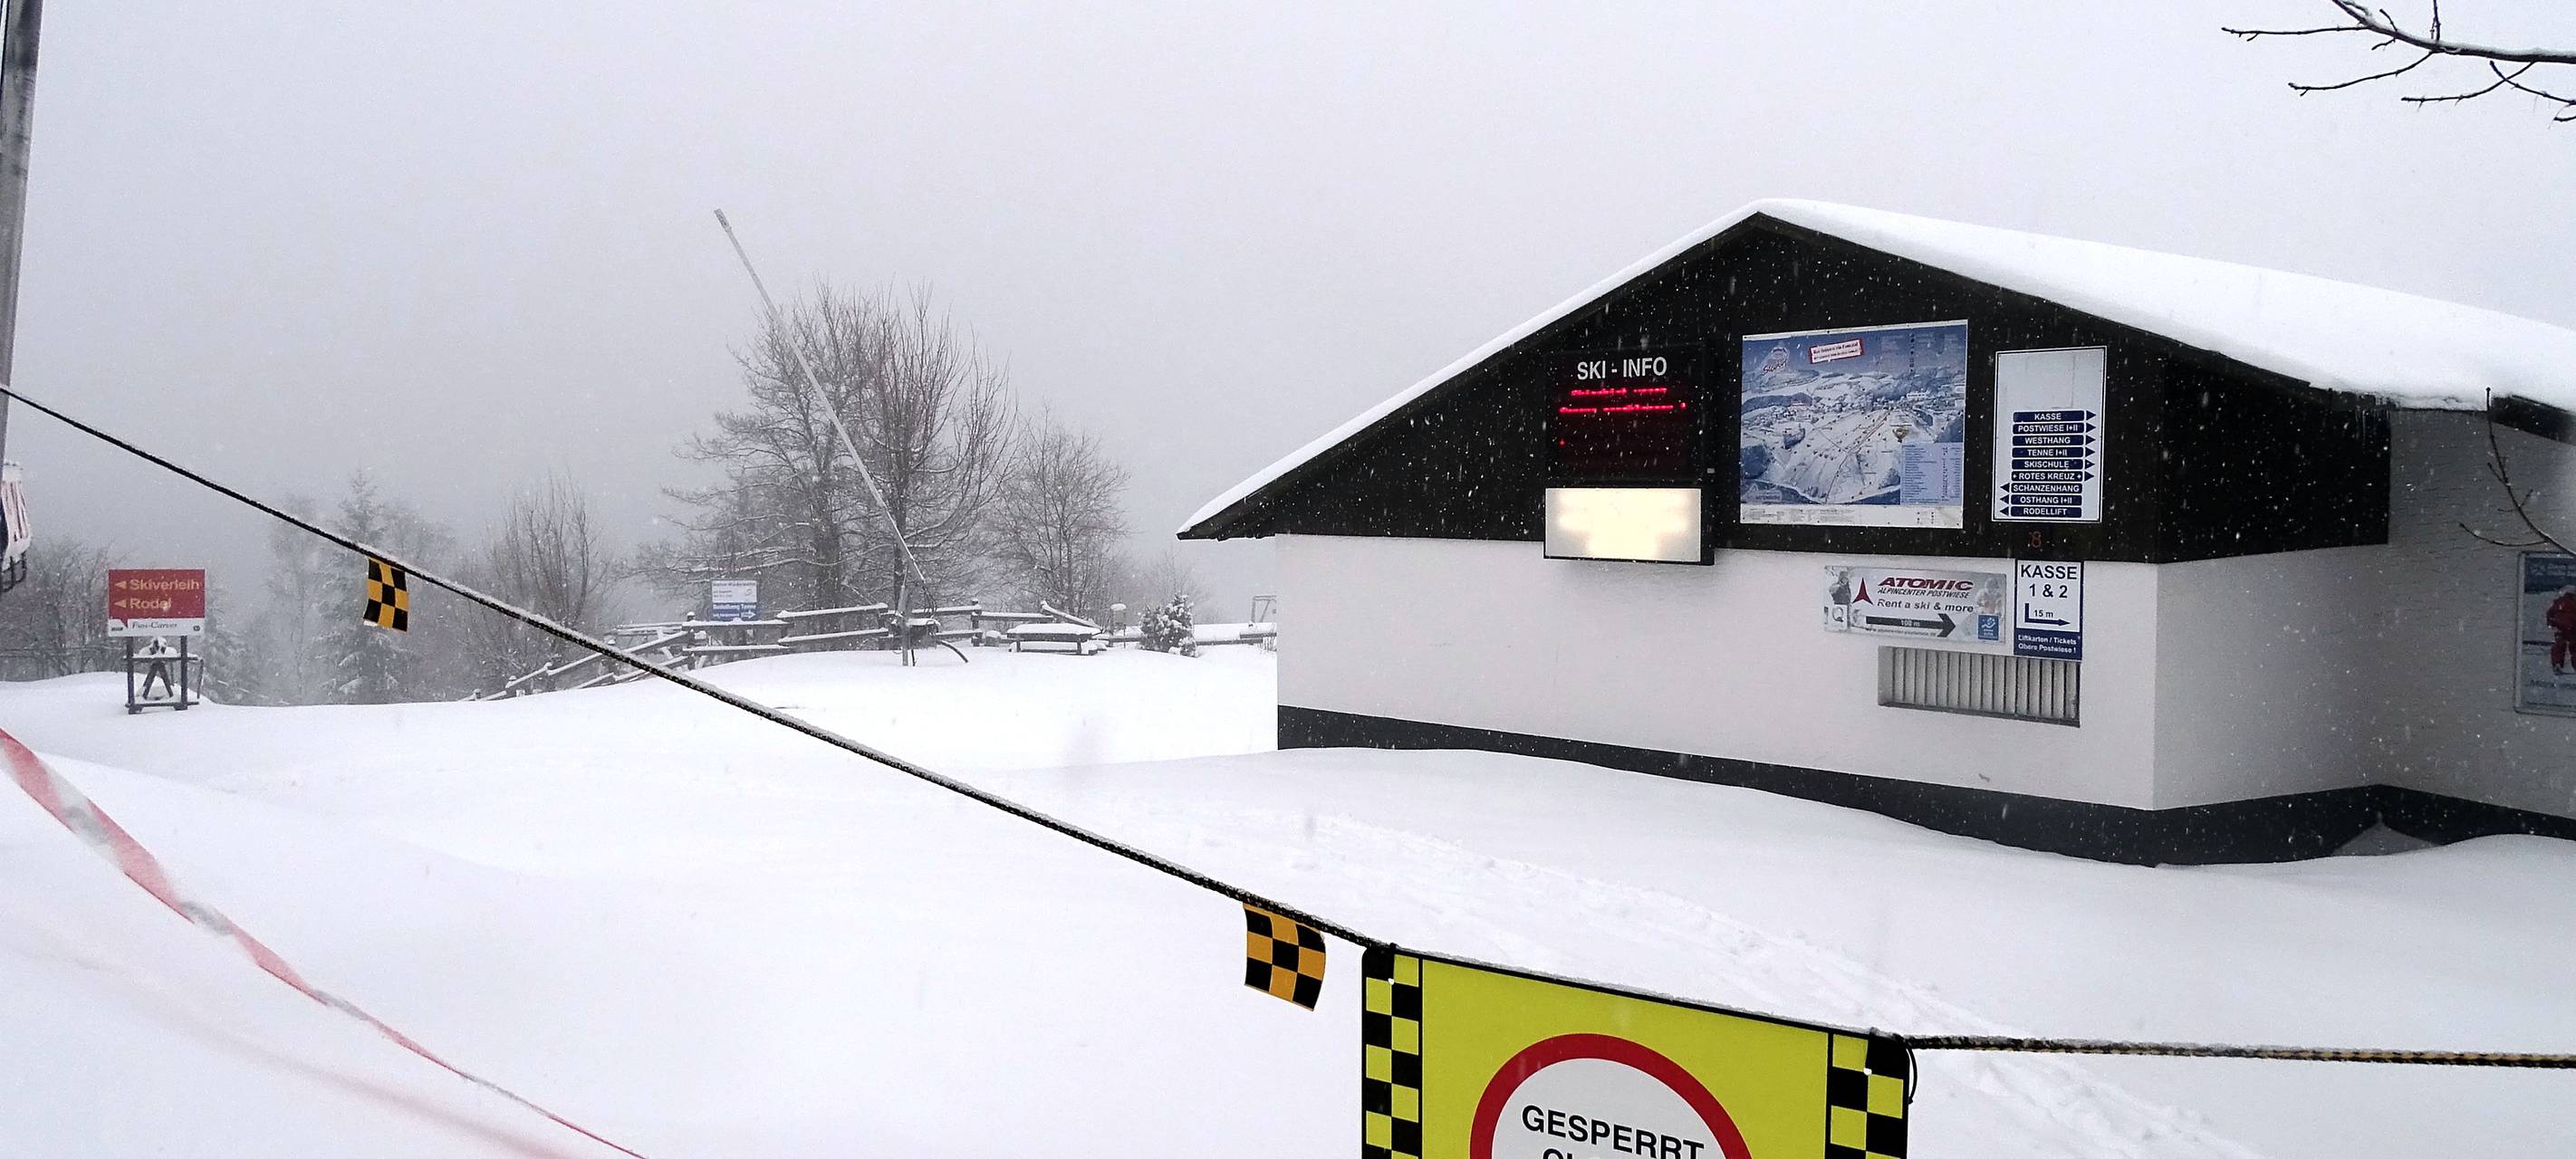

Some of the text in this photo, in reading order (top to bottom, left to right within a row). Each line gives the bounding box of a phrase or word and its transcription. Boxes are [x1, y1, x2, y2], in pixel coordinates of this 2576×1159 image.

[1577, 360, 1606, 380] SKI
[1622, 356, 1668, 378] INFO
[2018, 425, 2064, 433] POSTWIESE
[2024, 436, 2071, 445] WESTHANG
[2013, 484, 2080, 493] SCHANZENHANG
[2020, 496, 2059, 504] OSTHANG
[2023, 507, 2068, 515] RODELLIFT
[2021, 565, 2077, 580] KASSE
[130, 579, 200, 591] Skiverleih
[1878, 577, 1974, 590] ATOMIC
[1877, 587, 1970, 599] ALPINCENTER POSTWIESE
[2029, 583, 2068, 599] 1 & 2
[130, 598, 172, 610] Rodel
[1878, 599, 1902, 608] Rent
[1914, 601, 1930, 609] ski
[1934, 602, 1941, 610] &
[1945, 604, 1974, 613] more
[2033, 609, 2043, 618] 15
[2018, 635, 2049, 643] Liftkarten
[2053, 637, 2077, 645] Tickets
[2039, 644, 2072, 653] Postwiese
[1521, 1105, 1705, 1159] GESPERRT
